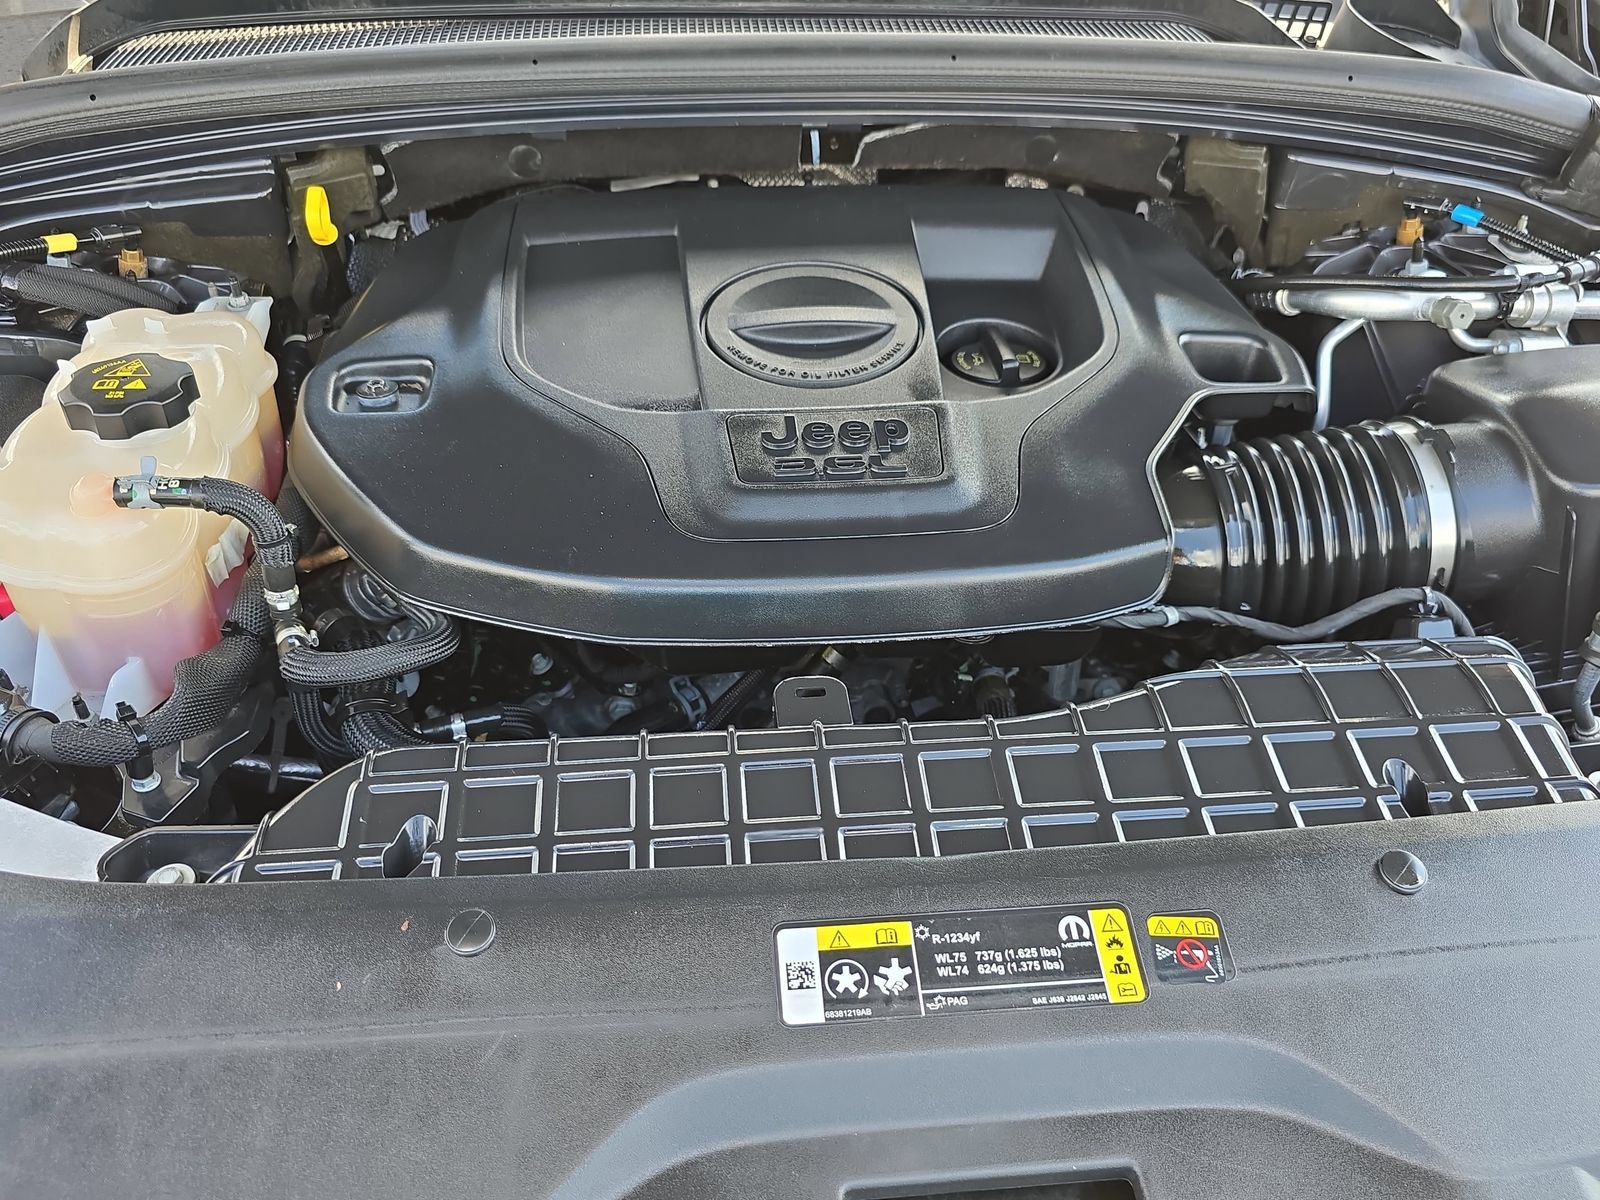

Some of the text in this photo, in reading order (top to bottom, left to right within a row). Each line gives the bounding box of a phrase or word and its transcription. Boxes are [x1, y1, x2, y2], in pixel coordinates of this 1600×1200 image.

[727, 344, 768, 371] REMOVE
[770, 366, 796, 378] FOR
[800, 370, 822, 380] OIL
[826, 365, 869, 380] FILTER
[760, 414, 910, 453] Jeep
[932, 931, 981, 944] R-1234yf
[1061, 941, 1093, 949] MOPAR
[935, 946, 1062, 964] WL75 737g (1.625 lbs)
[937, 958, 1065, 977] WL74 624g (1.375 lbs)
[947, 996, 969, 1006] PAG
[1032, 997, 1048, 1005] SAE
[825, 1008, 872, 1018] 68381219AB
